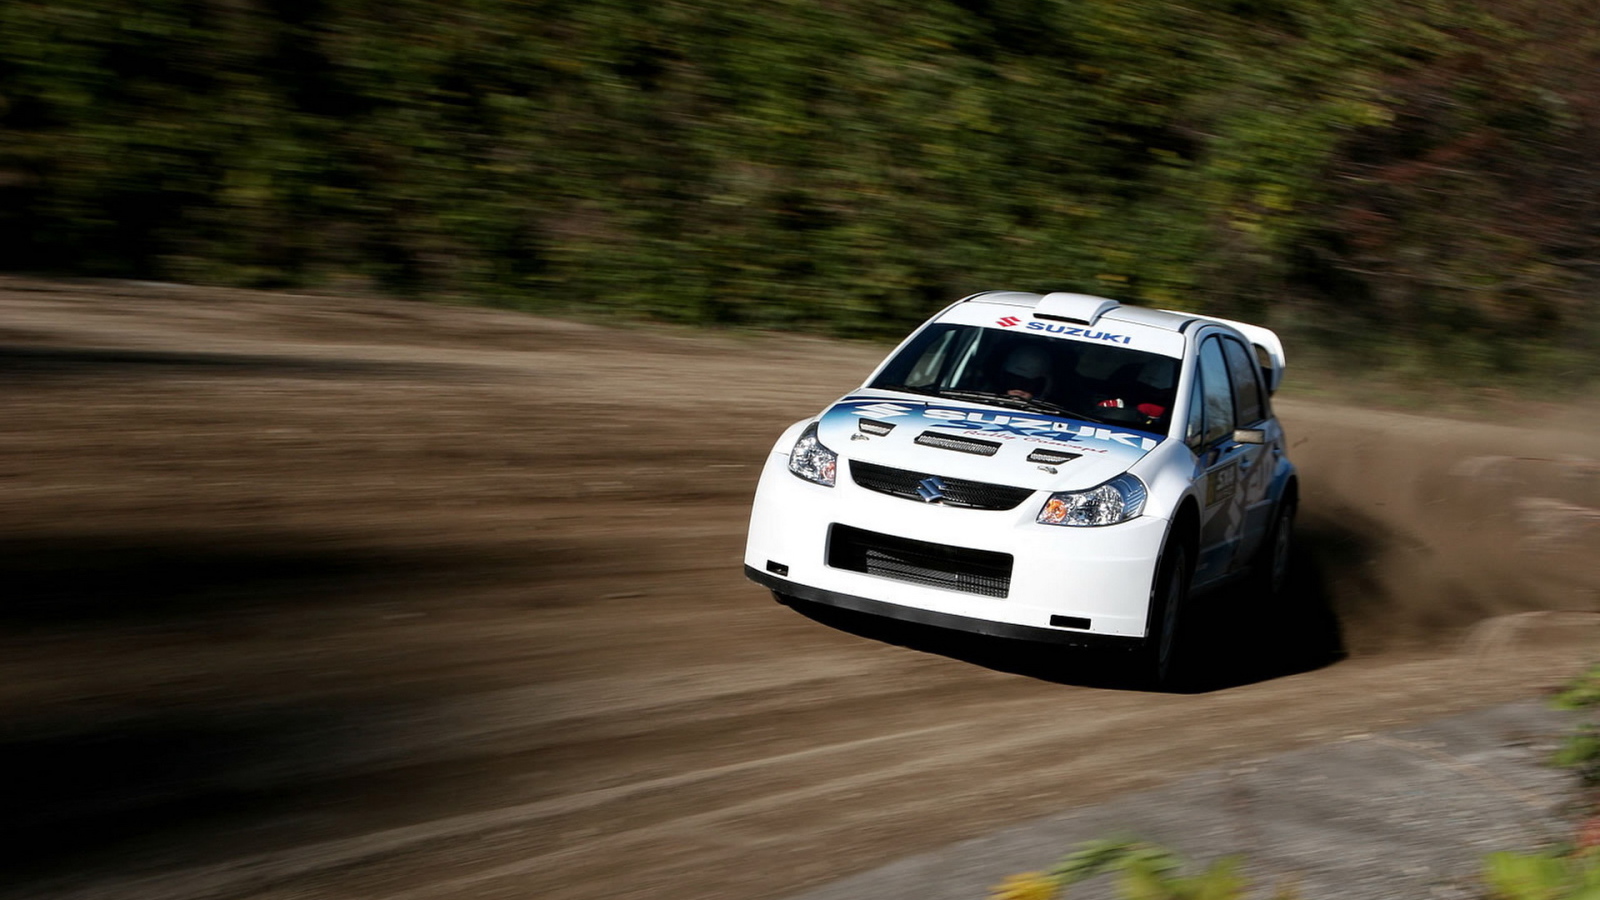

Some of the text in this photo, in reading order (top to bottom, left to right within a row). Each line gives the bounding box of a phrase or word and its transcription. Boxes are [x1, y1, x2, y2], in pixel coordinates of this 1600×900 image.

[1025, 321, 1131, 345] SUZUKI
[922, 408, 1158, 452] SUZUKI
[929, 418, 1084, 443] SX4
[963, 429, 1110, 454] Rally Concept
